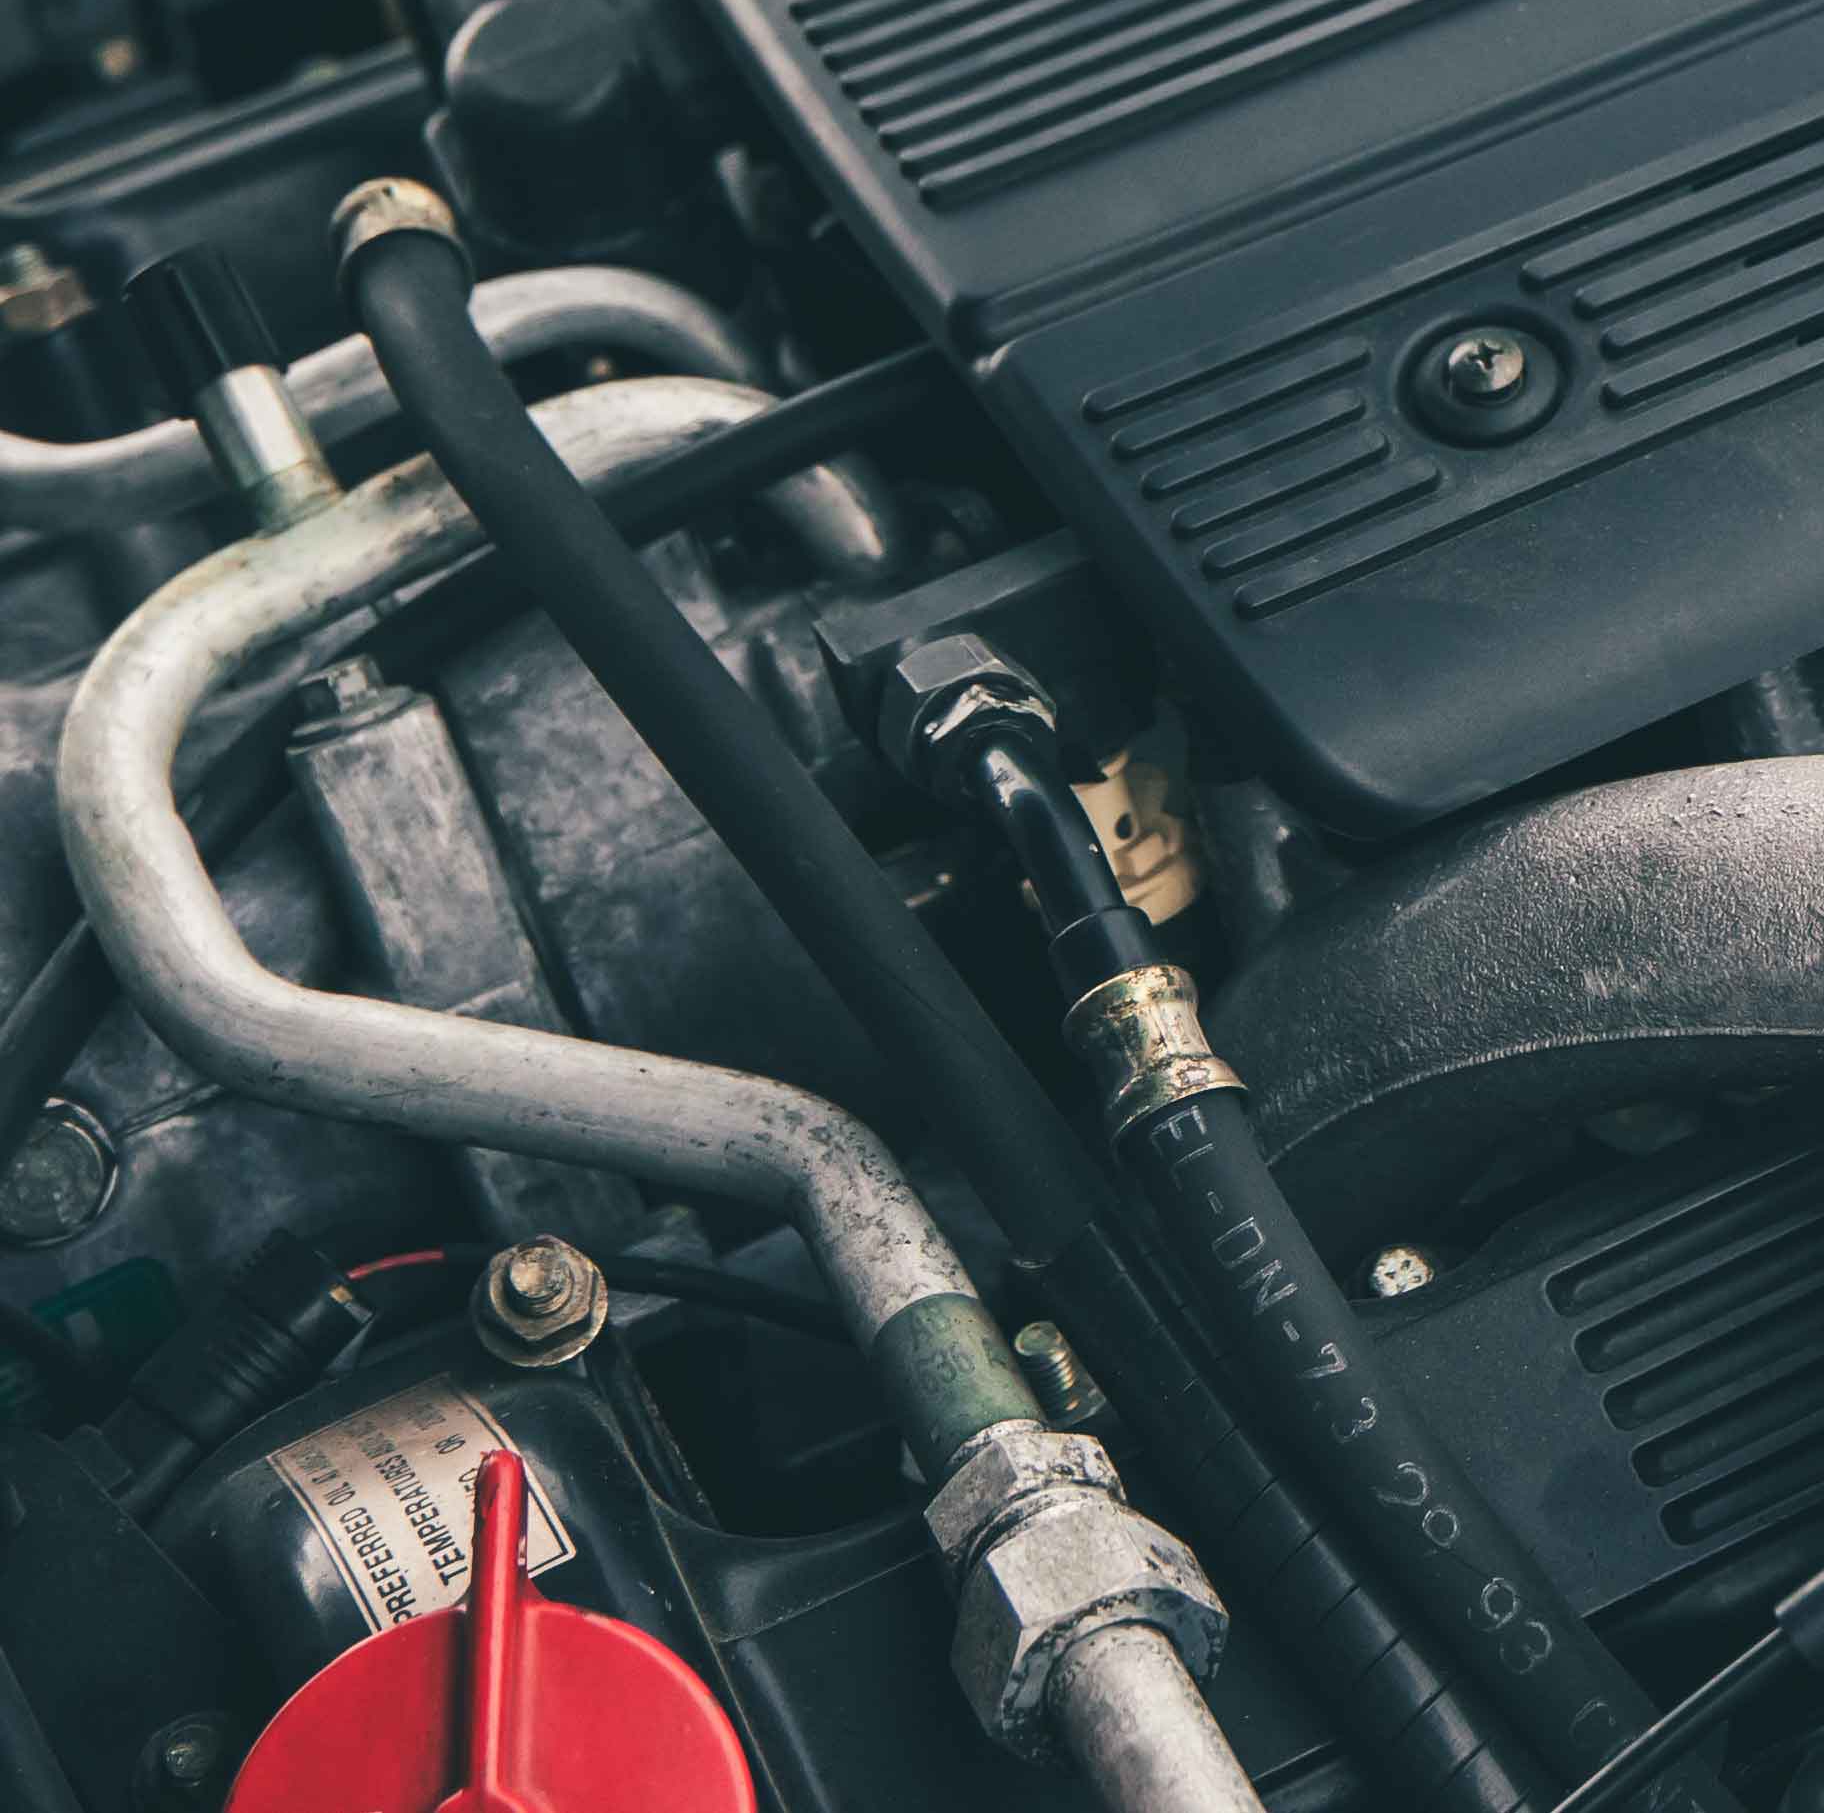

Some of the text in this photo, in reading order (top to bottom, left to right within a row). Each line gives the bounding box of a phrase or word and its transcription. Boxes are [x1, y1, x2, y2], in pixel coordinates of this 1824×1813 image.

[322, 1481, 356, 1507] OIL
[374, 1454, 469, 1588] TEMPERATURES
[338, 1506, 423, 1625] PREFERRED
